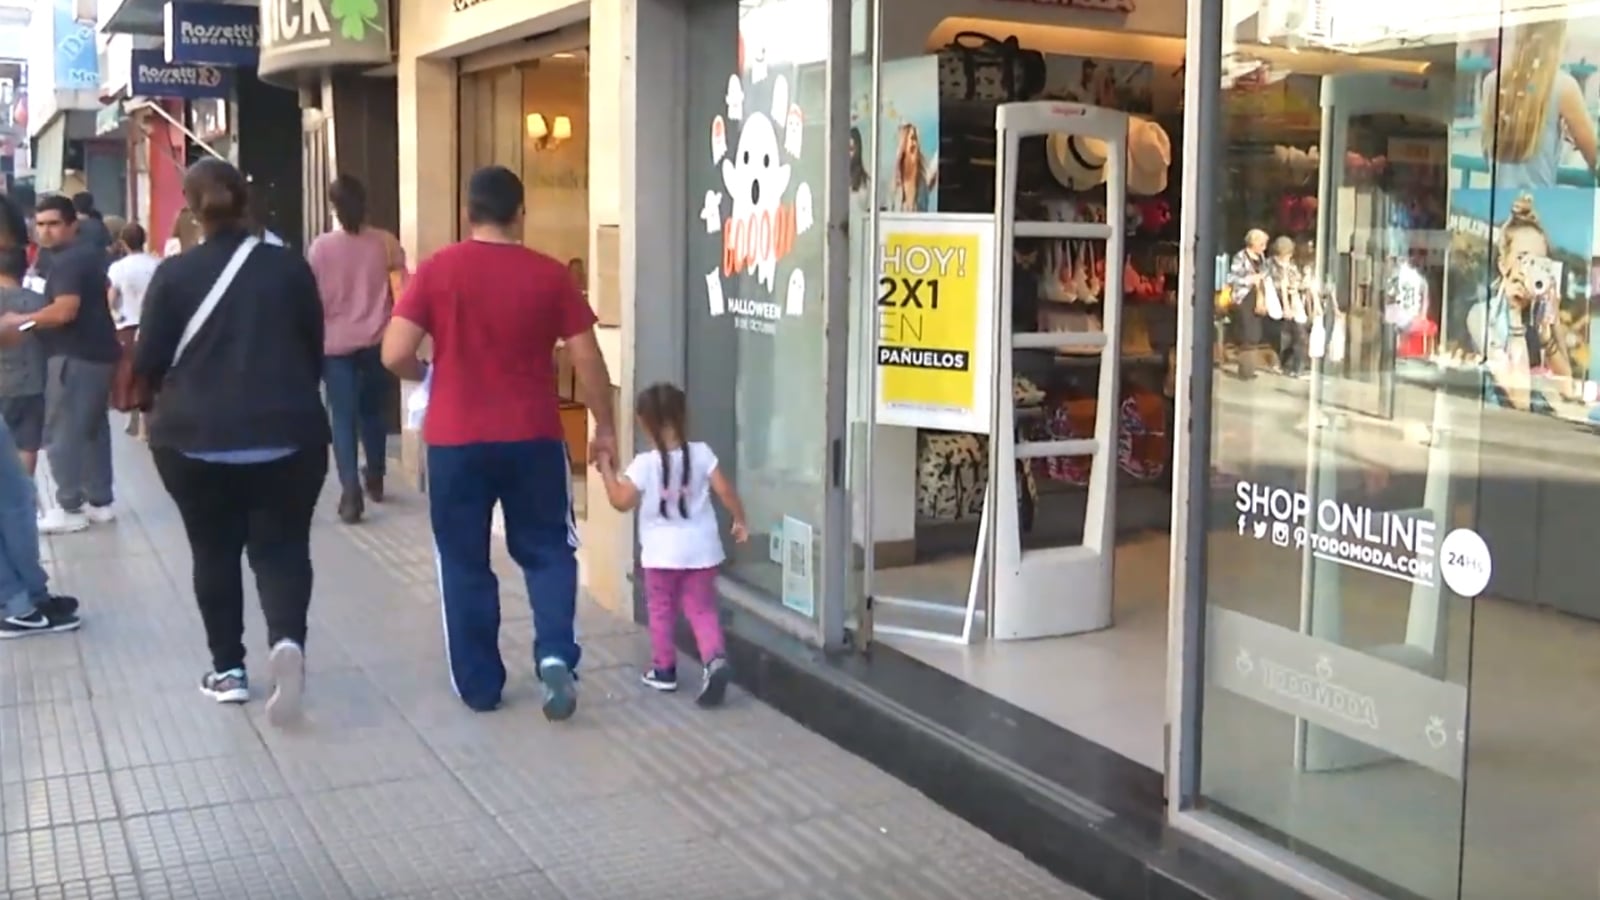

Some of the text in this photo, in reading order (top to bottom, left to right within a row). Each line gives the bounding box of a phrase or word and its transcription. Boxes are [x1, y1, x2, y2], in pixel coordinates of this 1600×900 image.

[181, 21, 254, 39] Rossetti
[139, 64, 197, 81] Rossetti
[879, 244, 968, 277] HOY!
[727, 297, 781, 320] HALLOWEEN
[878, 276, 939, 309] 2X1
[879, 310, 923, 342] EN
[880, 348, 965, 368] PAÑUELOS
[1236, 480, 1436, 556] SHOP ONLINE
[1310, 533, 1434, 578] TODOMODA.COM
